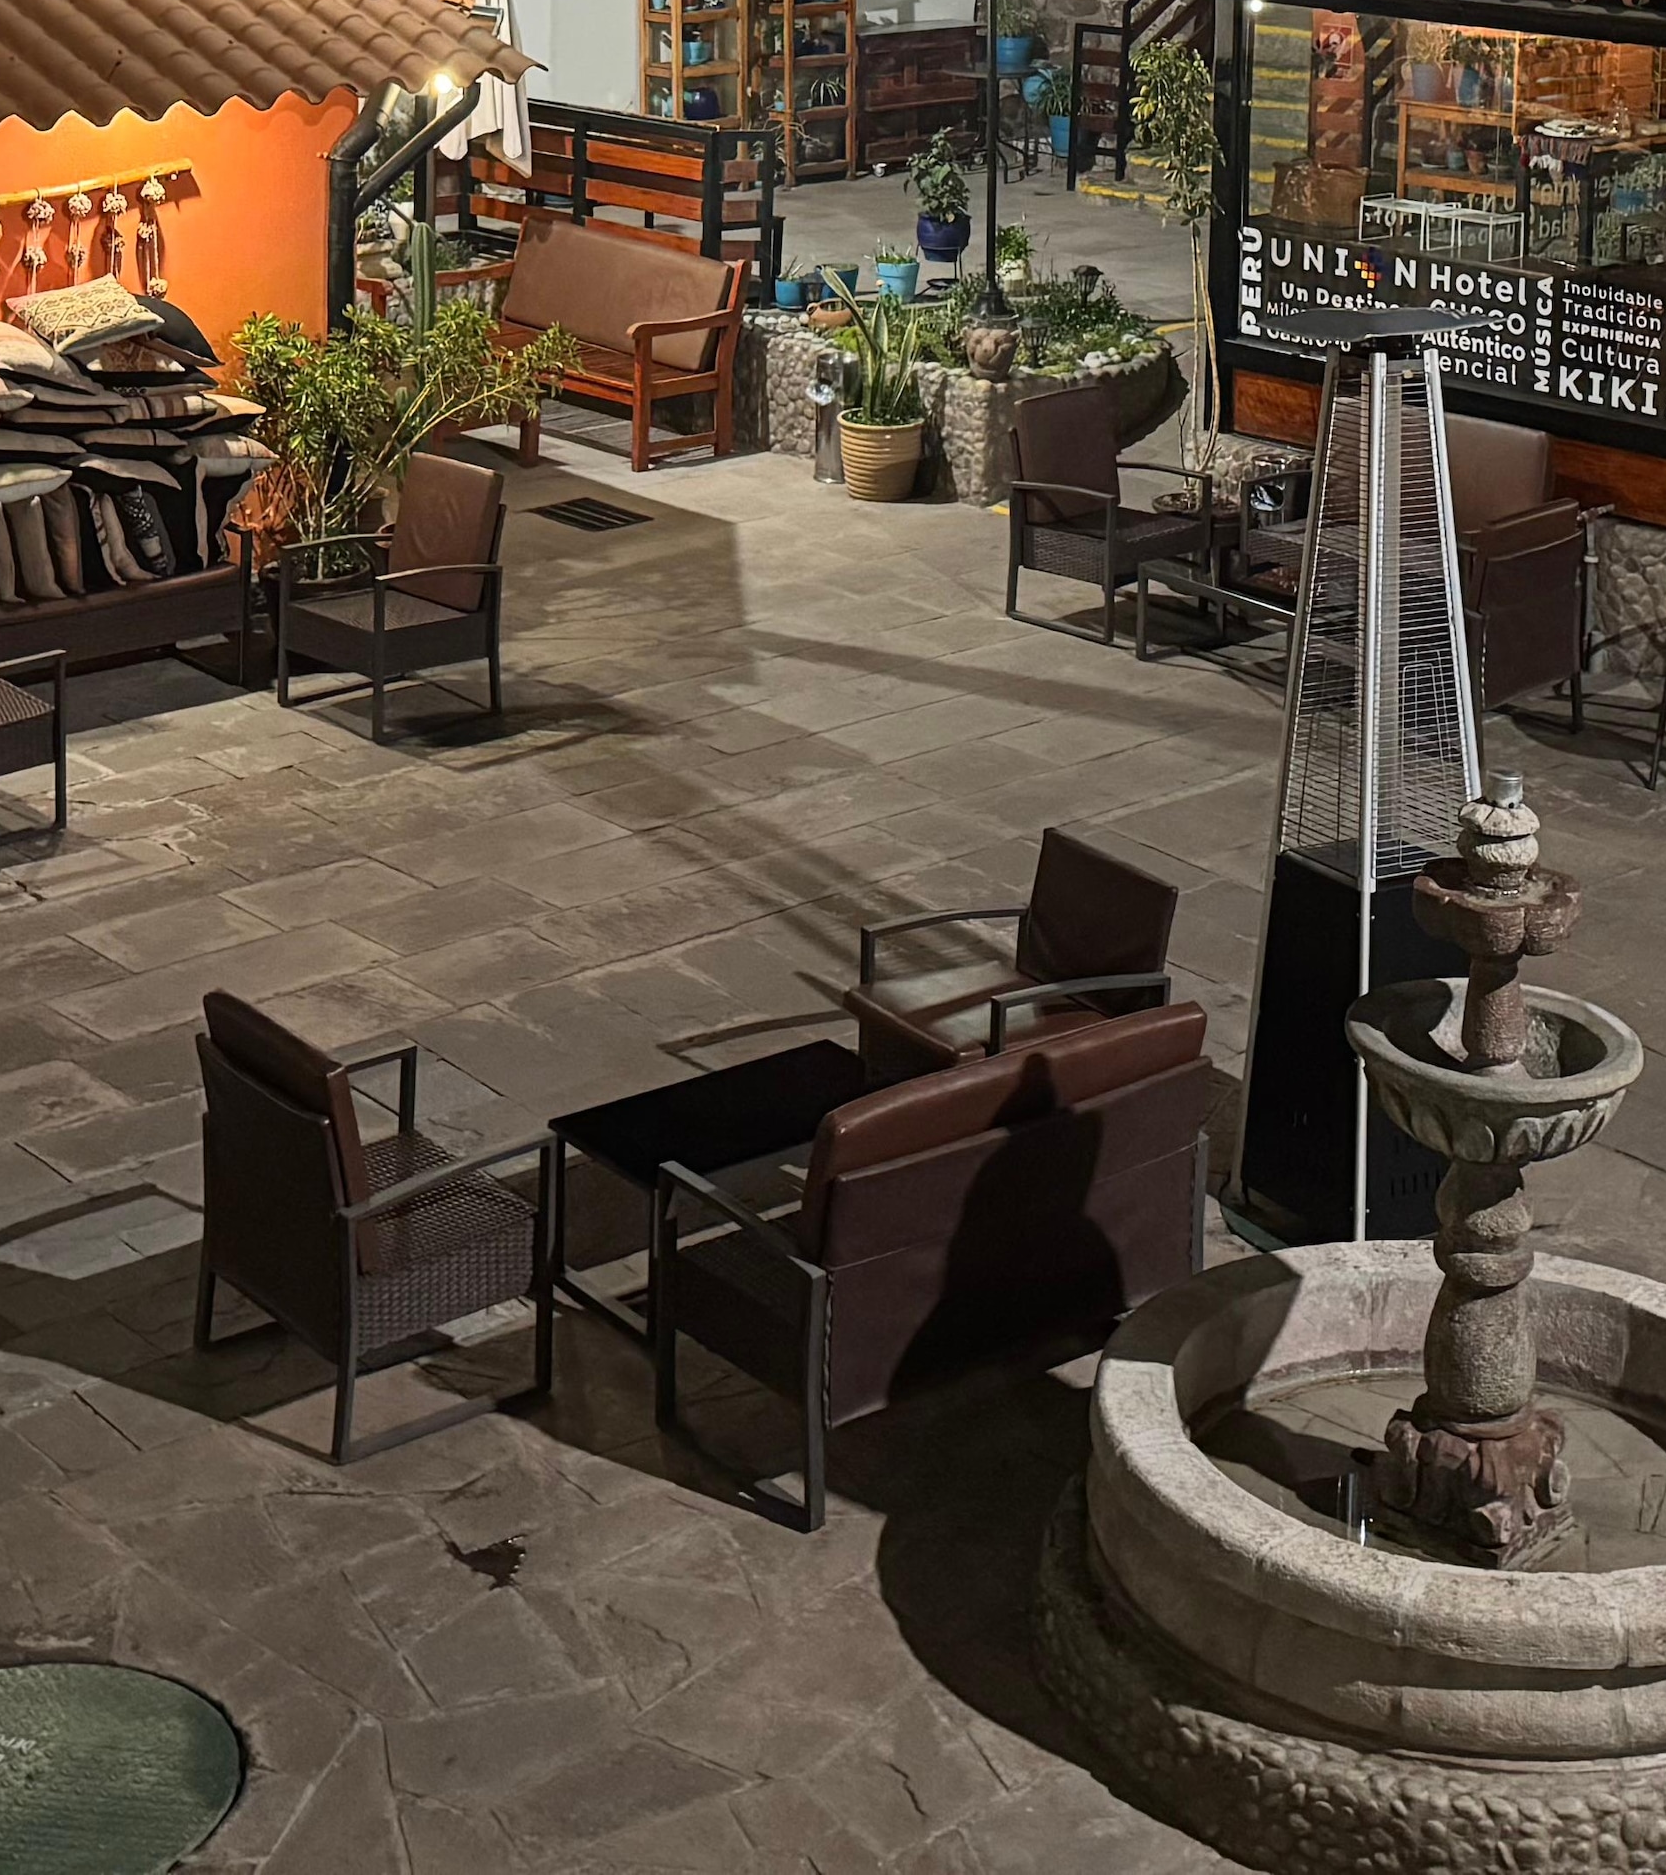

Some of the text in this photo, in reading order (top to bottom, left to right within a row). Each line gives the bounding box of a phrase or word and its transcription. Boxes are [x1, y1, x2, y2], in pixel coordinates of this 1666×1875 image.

[1238, 226, 1263, 337] PERÚ
[1281, 281, 1309, 303] Un
[1429, 262, 1528, 307] Hotel
[1562, 279, 1664, 311] Inolvidable
[1561, 297, 1662, 332] Tradición
[1421, 328, 1527, 363] Auténtico
[1531, 275, 1555, 393] MÚSICA
[1561, 319, 1662, 350] EXPERIENCIA
[1561, 337, 1661, 376] Cultura
[1558, 365, 1659, 416] KIKI
